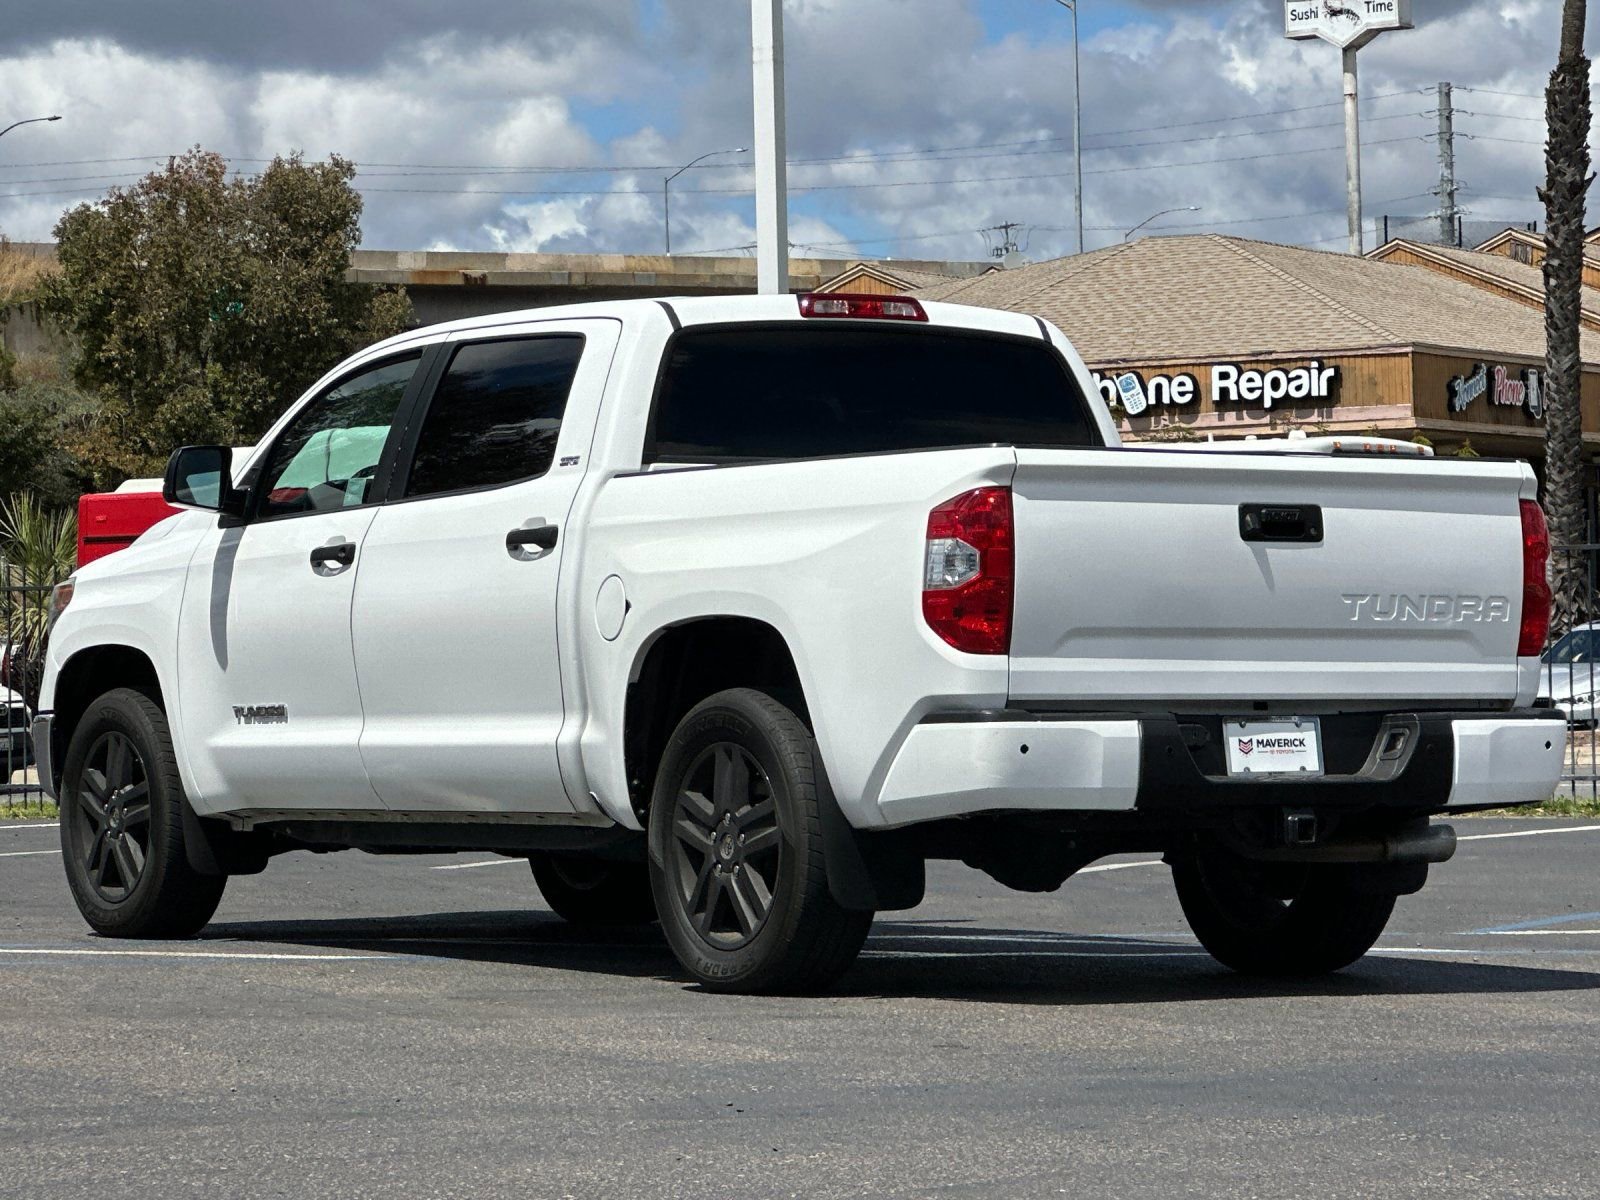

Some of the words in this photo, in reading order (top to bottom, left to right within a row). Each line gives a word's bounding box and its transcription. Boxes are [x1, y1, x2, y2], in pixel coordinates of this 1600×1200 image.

[1290, 7, 1318, 20] Sushi
[1364, 1, 1393, 13] Time
[1211, 361, 1335, 408] Repair
[1494, 366, 1526, 406] Phone
[1341, 594, 1511, 622] TUNDRA
[1256, 737, 1306, 748] MAVERICK
